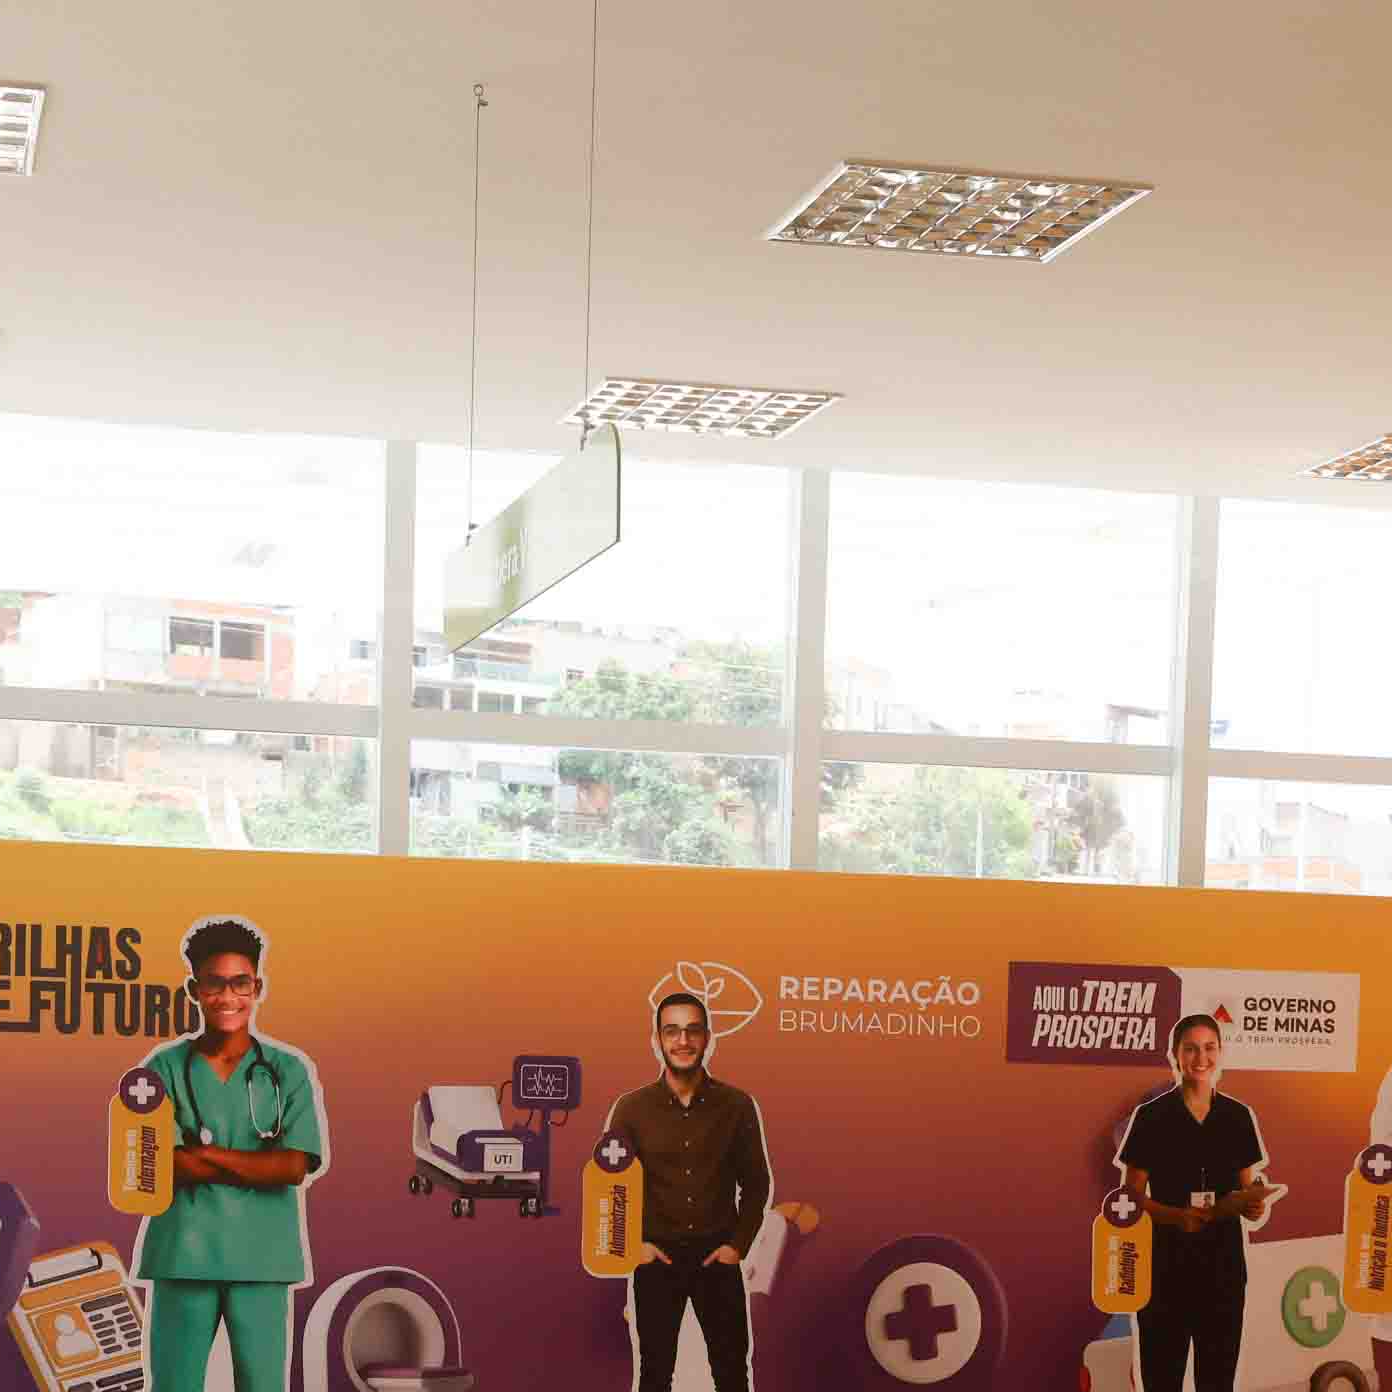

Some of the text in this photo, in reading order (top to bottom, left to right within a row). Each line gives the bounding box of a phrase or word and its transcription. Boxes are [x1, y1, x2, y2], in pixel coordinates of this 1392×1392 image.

[778, 975, 981, 1009] REPARAÇÃO
[1032, 980, 1157, 1014] AQUI O TREM
[1243, 997, 1336, 1014] GOVERNO
[29, 979, 200, 1038] FUTURO
[778, 1009, 982, 1038] BRUMADINHO
[1031, 1013, 1157, 1050] PROSPERA
[1243, 1015, 1336, 1034] DE MINAS
[493, 1154, 513, 1165] UTI
